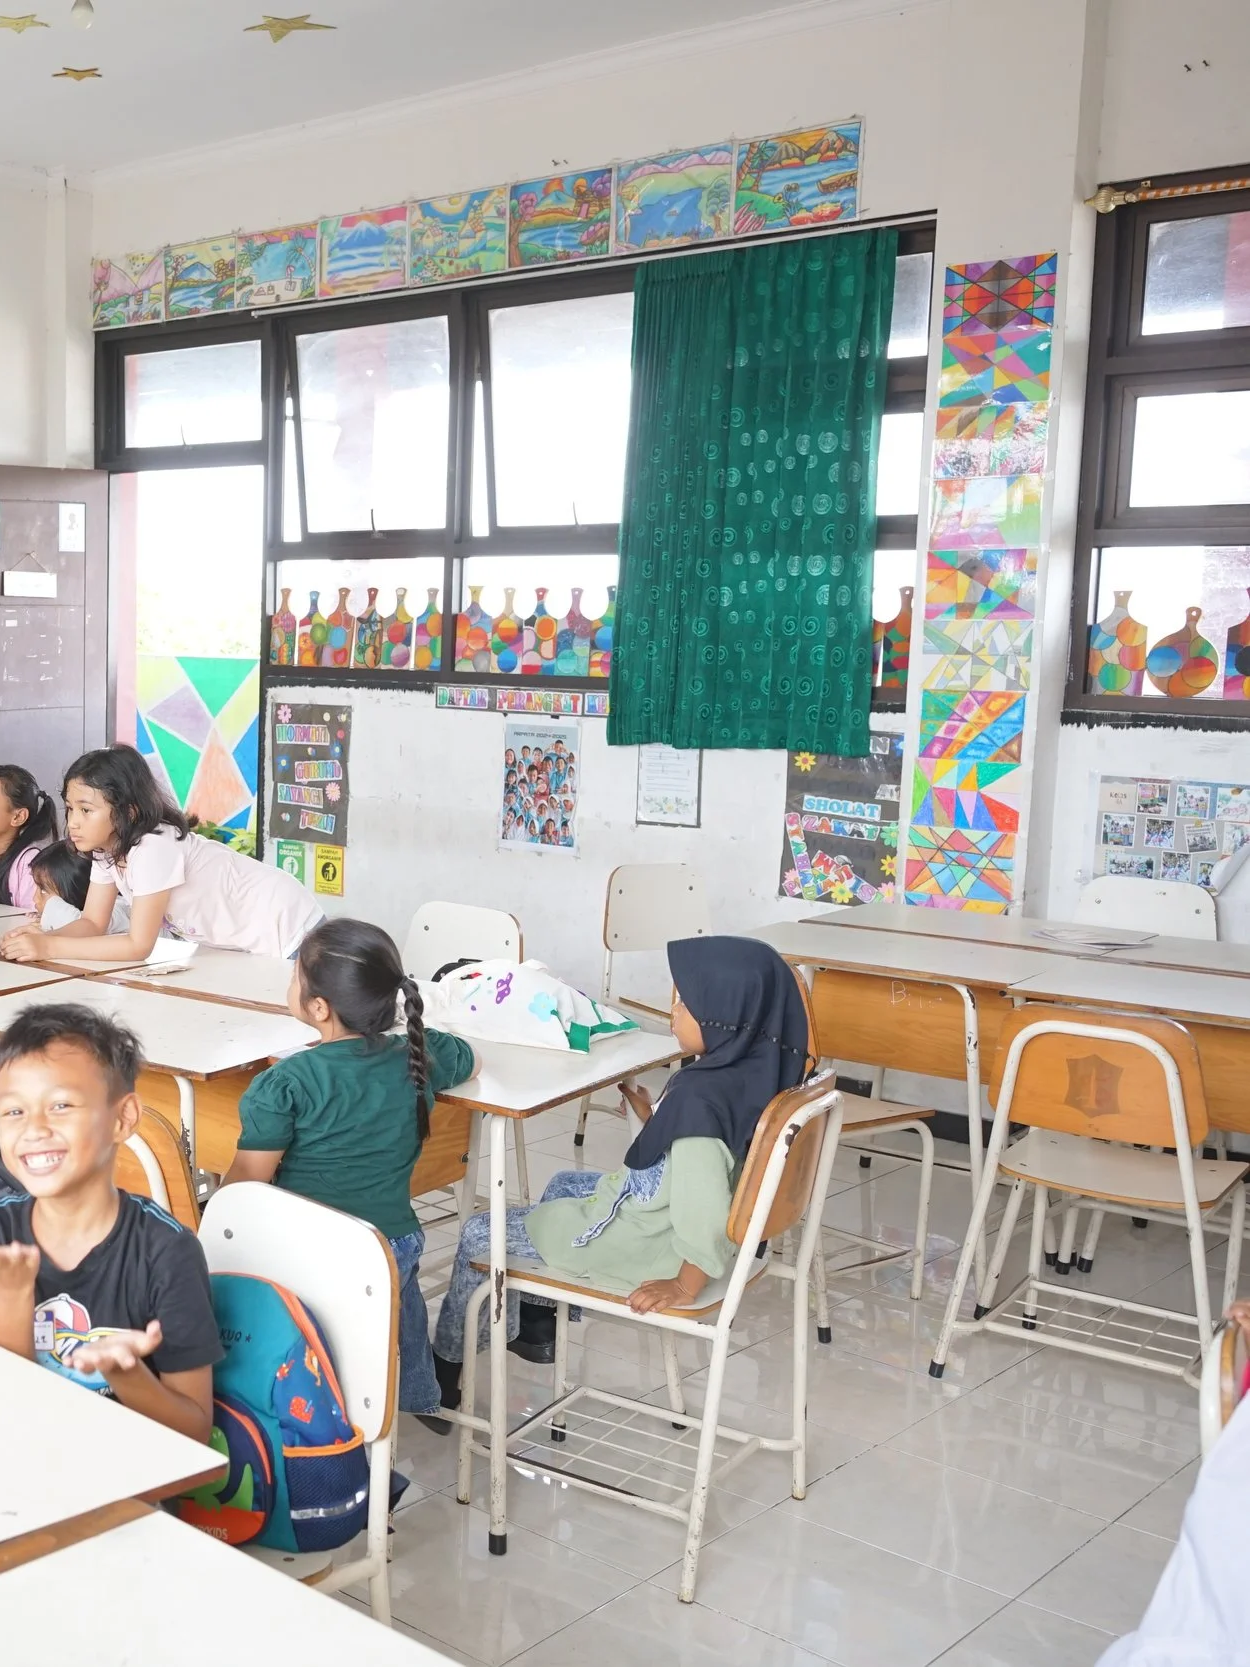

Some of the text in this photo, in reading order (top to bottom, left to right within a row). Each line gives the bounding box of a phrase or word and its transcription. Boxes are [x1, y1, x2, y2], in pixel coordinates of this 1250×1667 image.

[437, 687, 488, 707] DAFTAR
[496, 690, 582, 714] PERANGKAT
[276, 724, 329, 743] HORMATI
[295, 762, 341, 780] GURUMU
[278, 784, 323, 806] SAYANGI
[804, 797, 879, 819] SHOLAT
[802, 815, 880, 840] ZAKAT
[278, 849, 302, 857] ORGANIK
